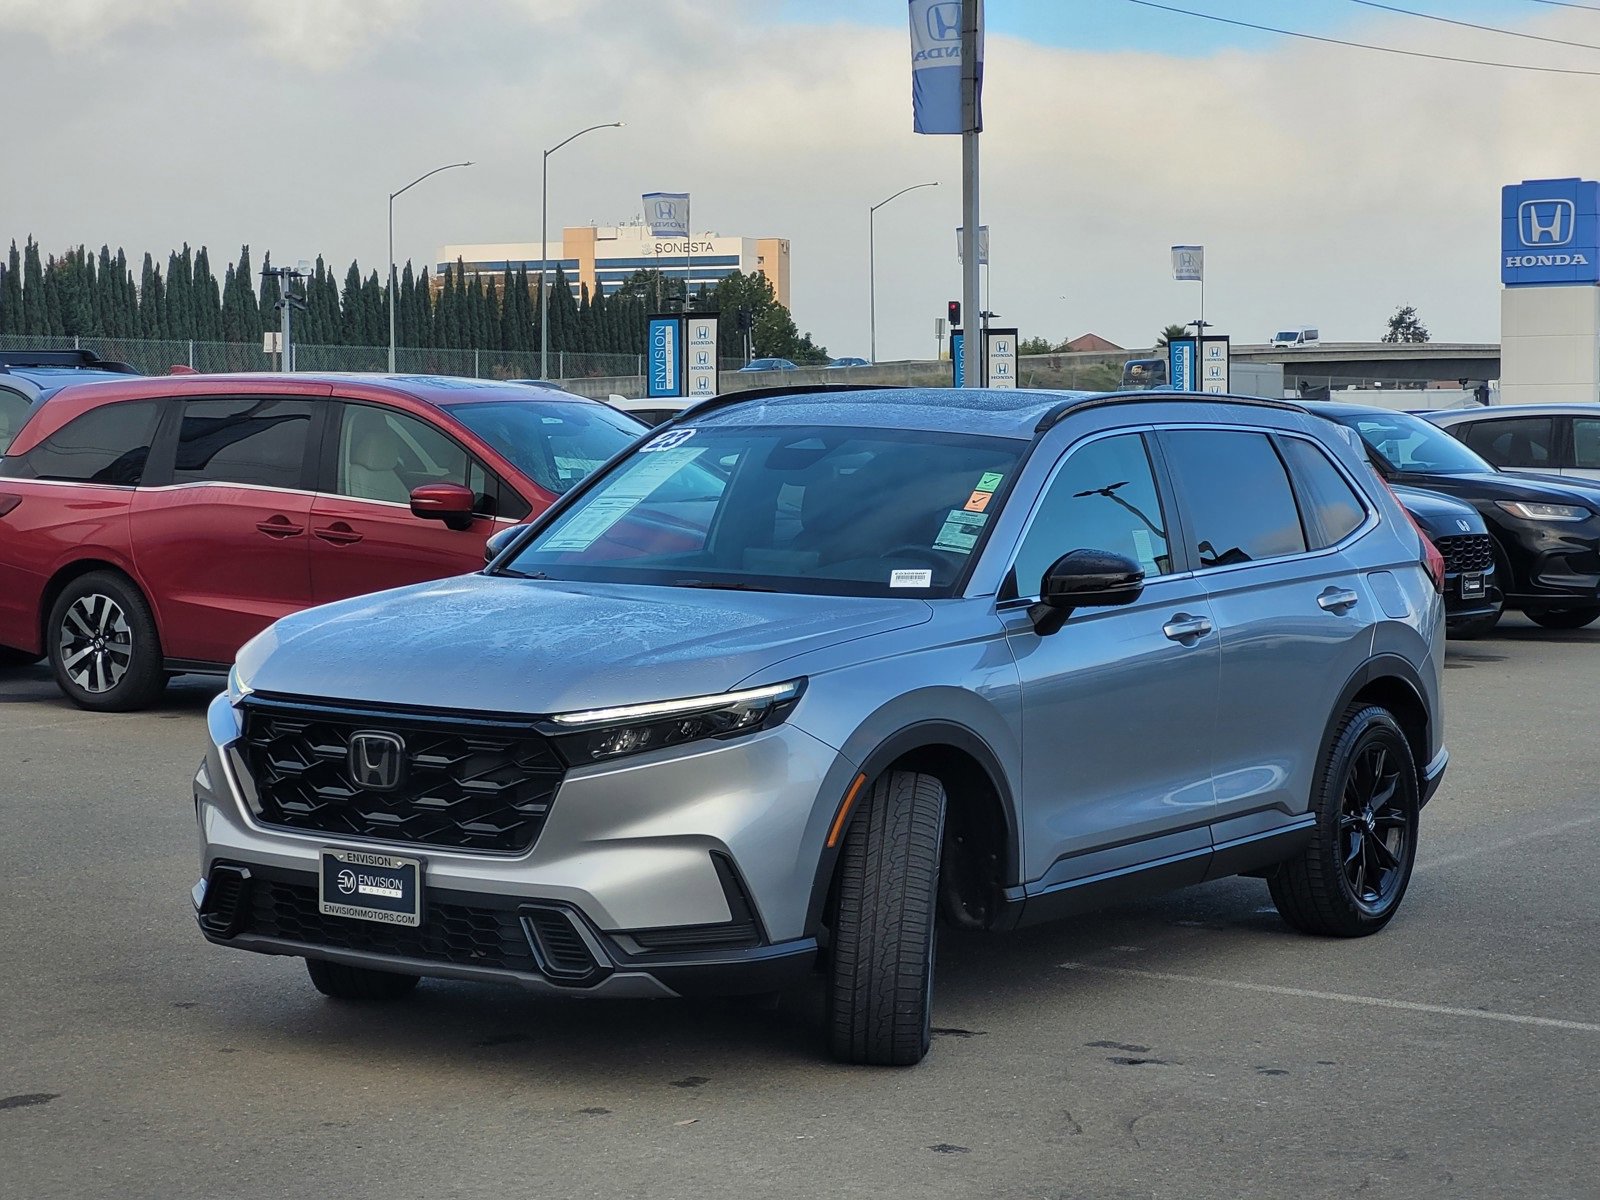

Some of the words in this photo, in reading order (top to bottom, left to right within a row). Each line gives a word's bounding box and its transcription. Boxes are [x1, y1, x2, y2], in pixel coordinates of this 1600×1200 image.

[655, 242, 715, 253] SONESTA
[1505, 254, 1589, 267] HONDA
[654, 325, 666, 390] ENVISION
[1174, 345, 1183, 390] NVISION
[645, 430, 692, 449] 23
[347, 852, 392, 867] ENVISION
[358, 874, 403, 890] ENVISION
[362, 887, 399, 896] MOTORS
[323, 904, 416, 925] ENVISIONMOTORS.COM
